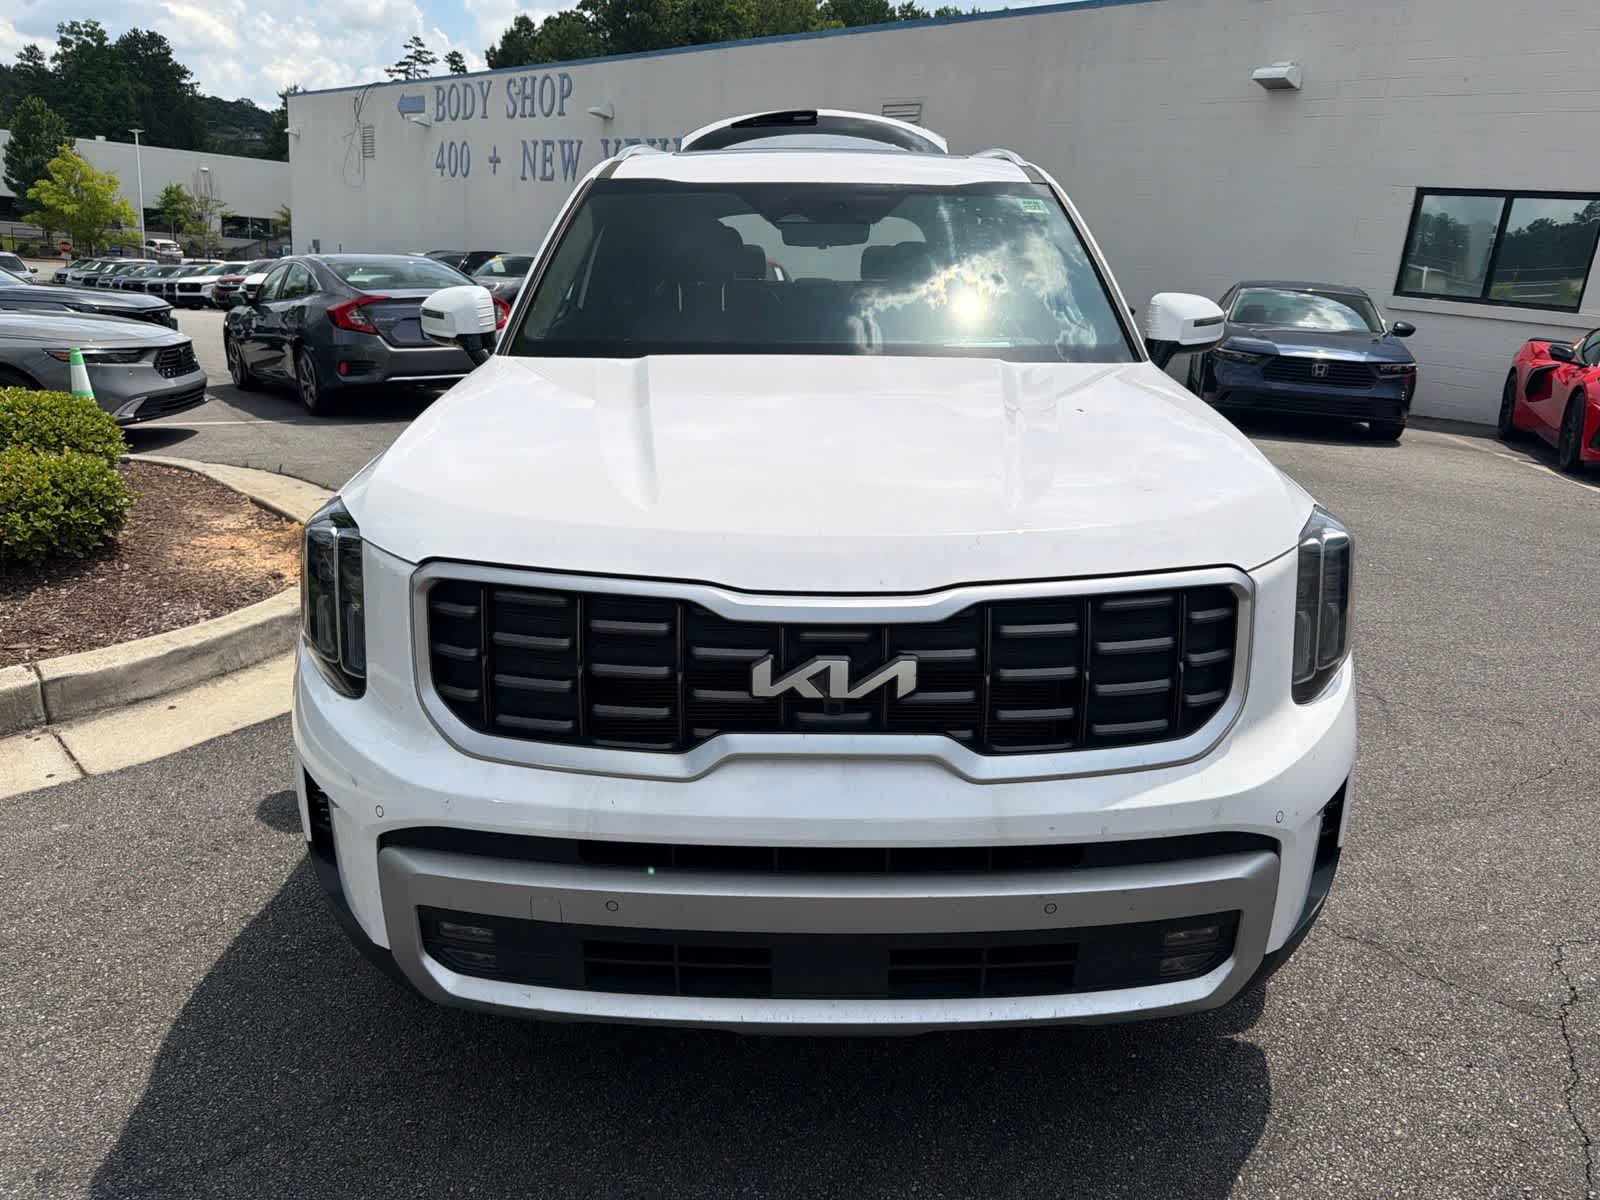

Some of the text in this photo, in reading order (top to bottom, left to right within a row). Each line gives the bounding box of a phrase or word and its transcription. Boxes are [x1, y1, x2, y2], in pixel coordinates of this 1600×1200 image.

[434, 72, 573, 121] BODY SHOP
[435, 140, 471, 178] 400
[488, 144, 501, 175] +
[520, 138, 583, 182] NEW
